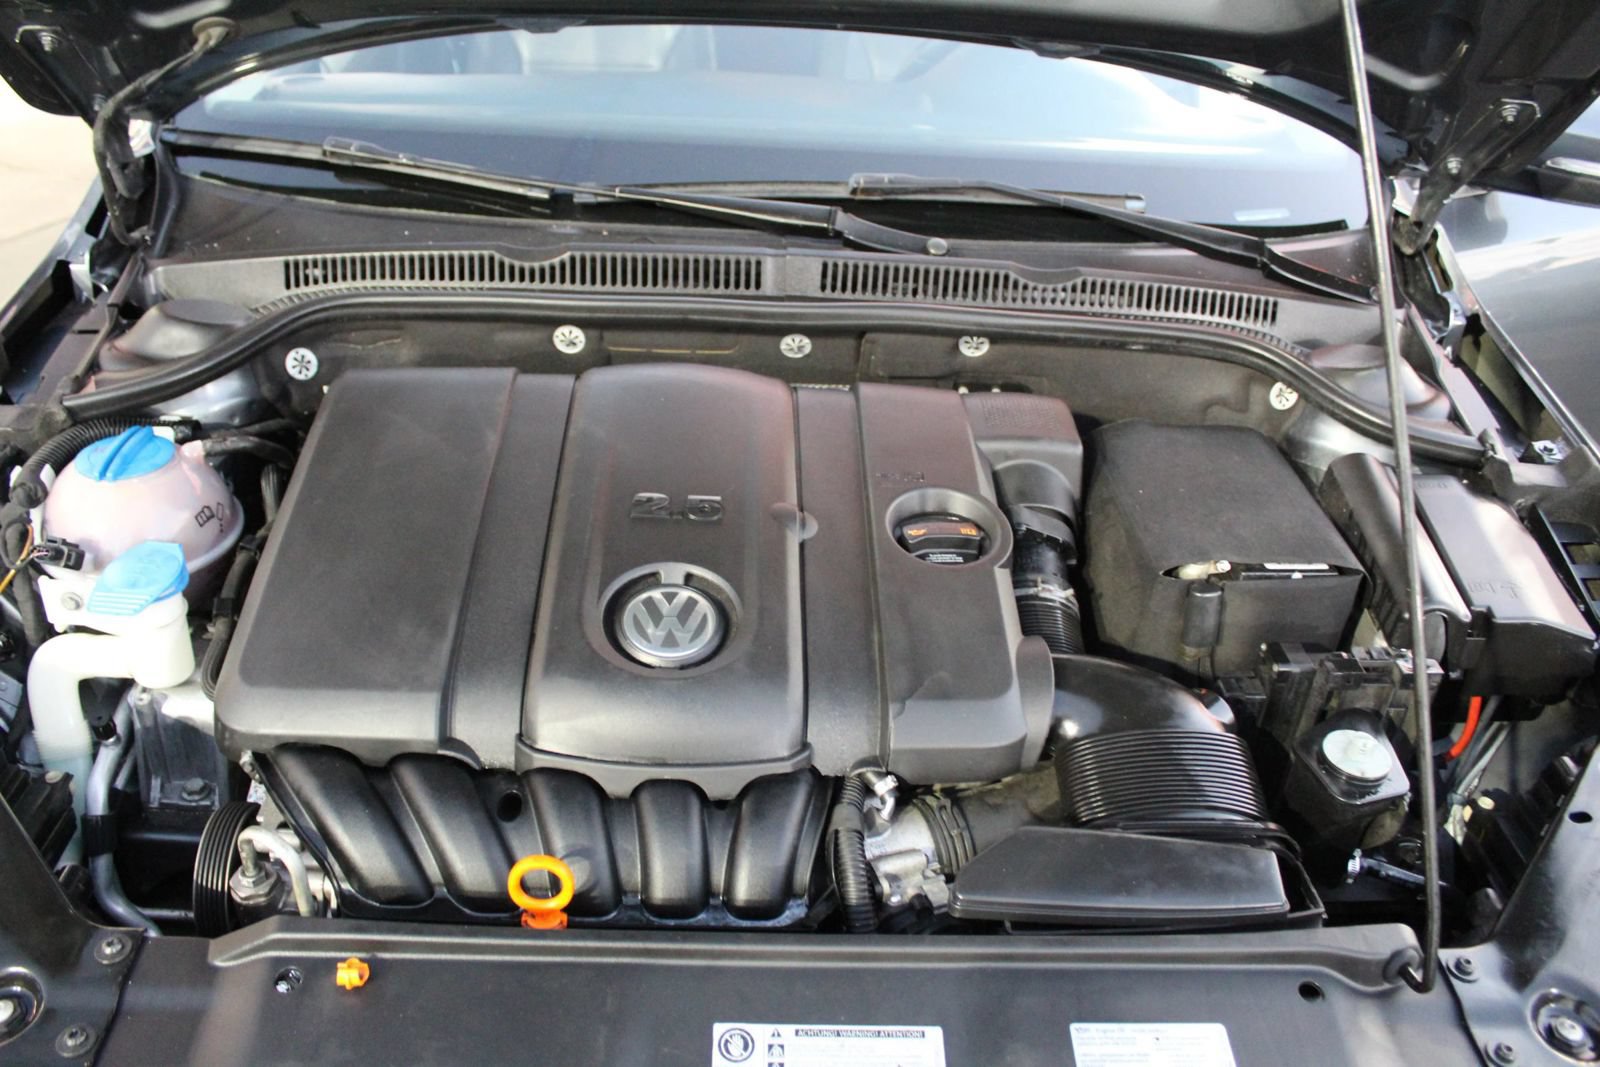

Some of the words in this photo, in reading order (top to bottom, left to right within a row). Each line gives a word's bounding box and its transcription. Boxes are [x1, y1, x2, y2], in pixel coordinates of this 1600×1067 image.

[630, 491, 724, 522] 2.5
[624, 586, 716, 657] VW
[839, 1029, 878, 1038] WARNING!
